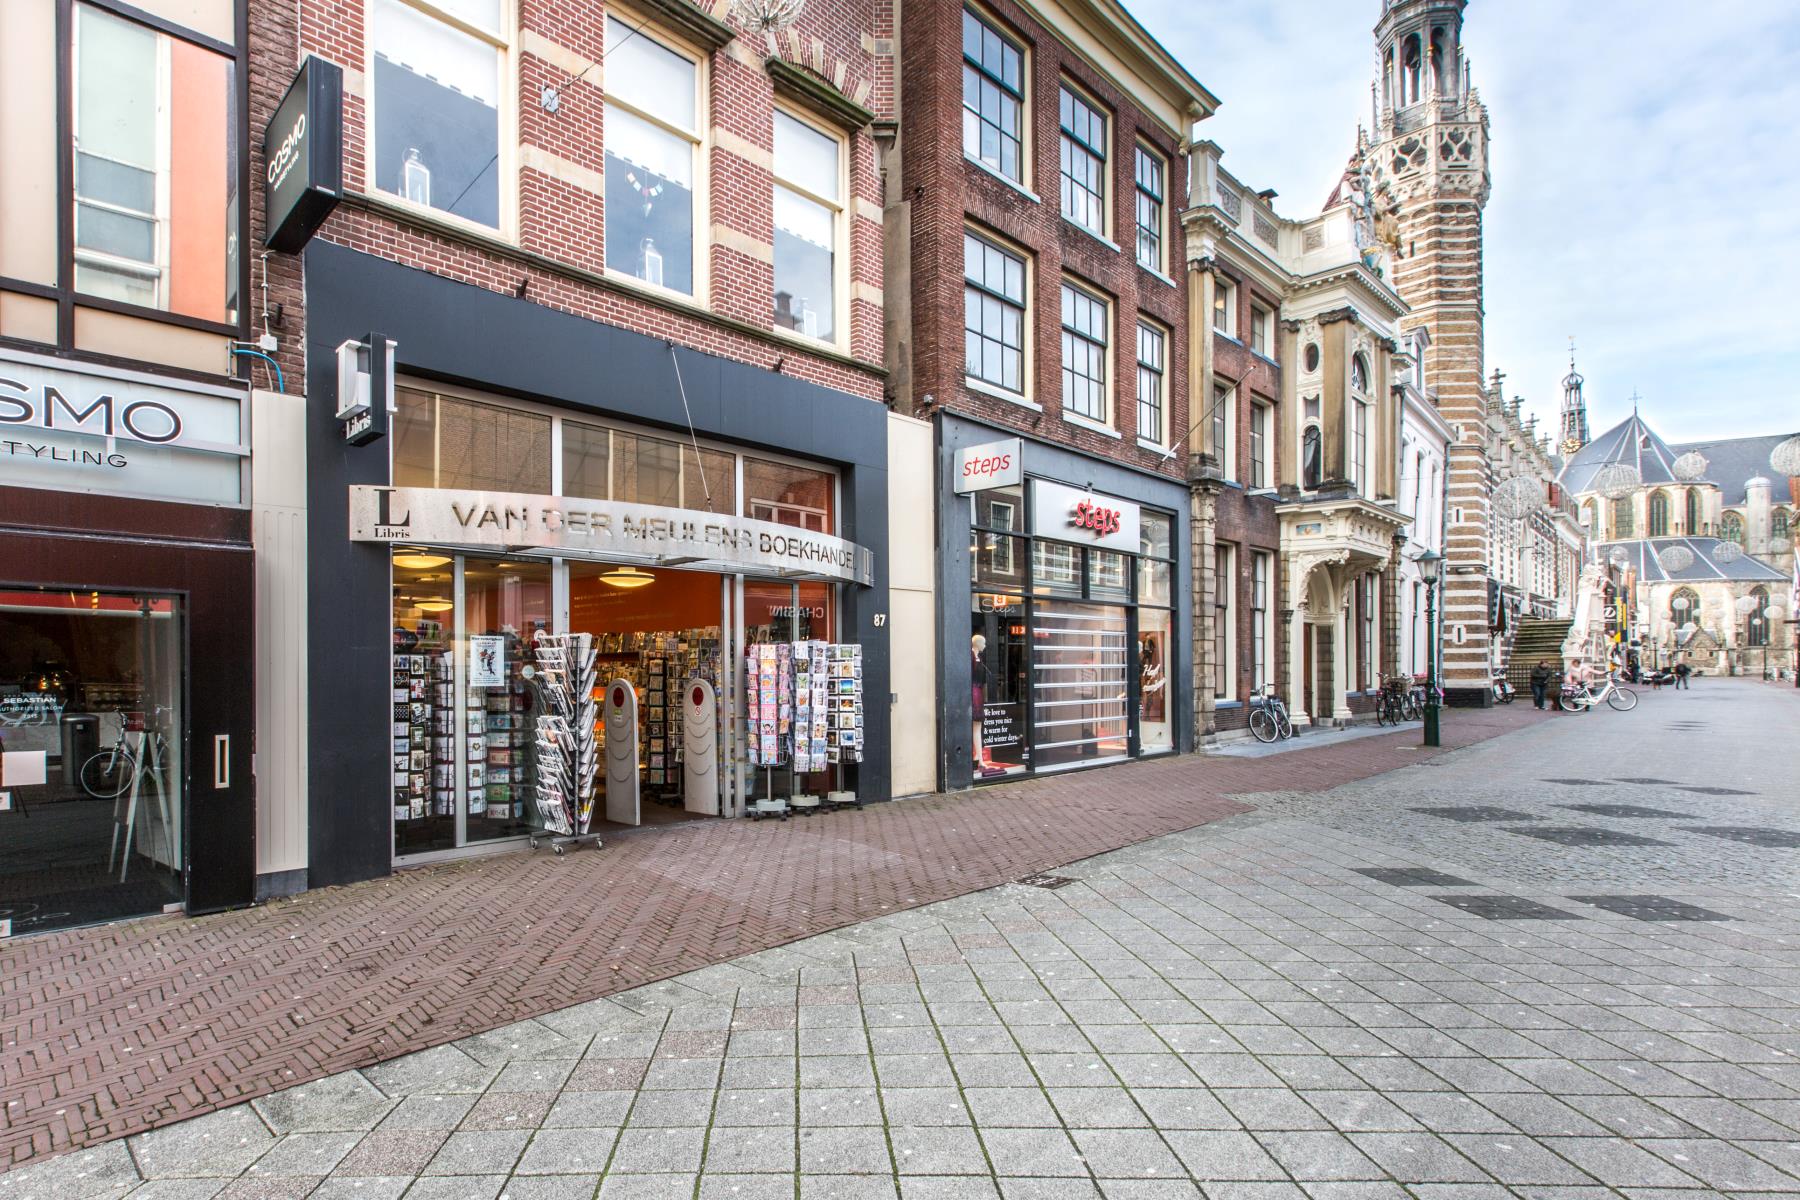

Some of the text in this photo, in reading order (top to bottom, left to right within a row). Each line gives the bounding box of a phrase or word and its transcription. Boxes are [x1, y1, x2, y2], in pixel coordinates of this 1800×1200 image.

[268, 113, 306, 184] COSMO
[3, 440, 129, 468] TYLING
[962, 454, 1011, 477] steps
[374, 488, 410, 527] L
[1074, 498, 1121, 538] steps
[374, 527, 410, 539] Libris
[451, 502, 857, 573] VAN DER MEULENS BOEKHANDEL
[873, 613, 886, 627] 87
[984, 708, 991, 716] We
[991, 708, 1000, 716] love
[995, 719, 1003, 727] you
[984, 727, 988, 735] &
